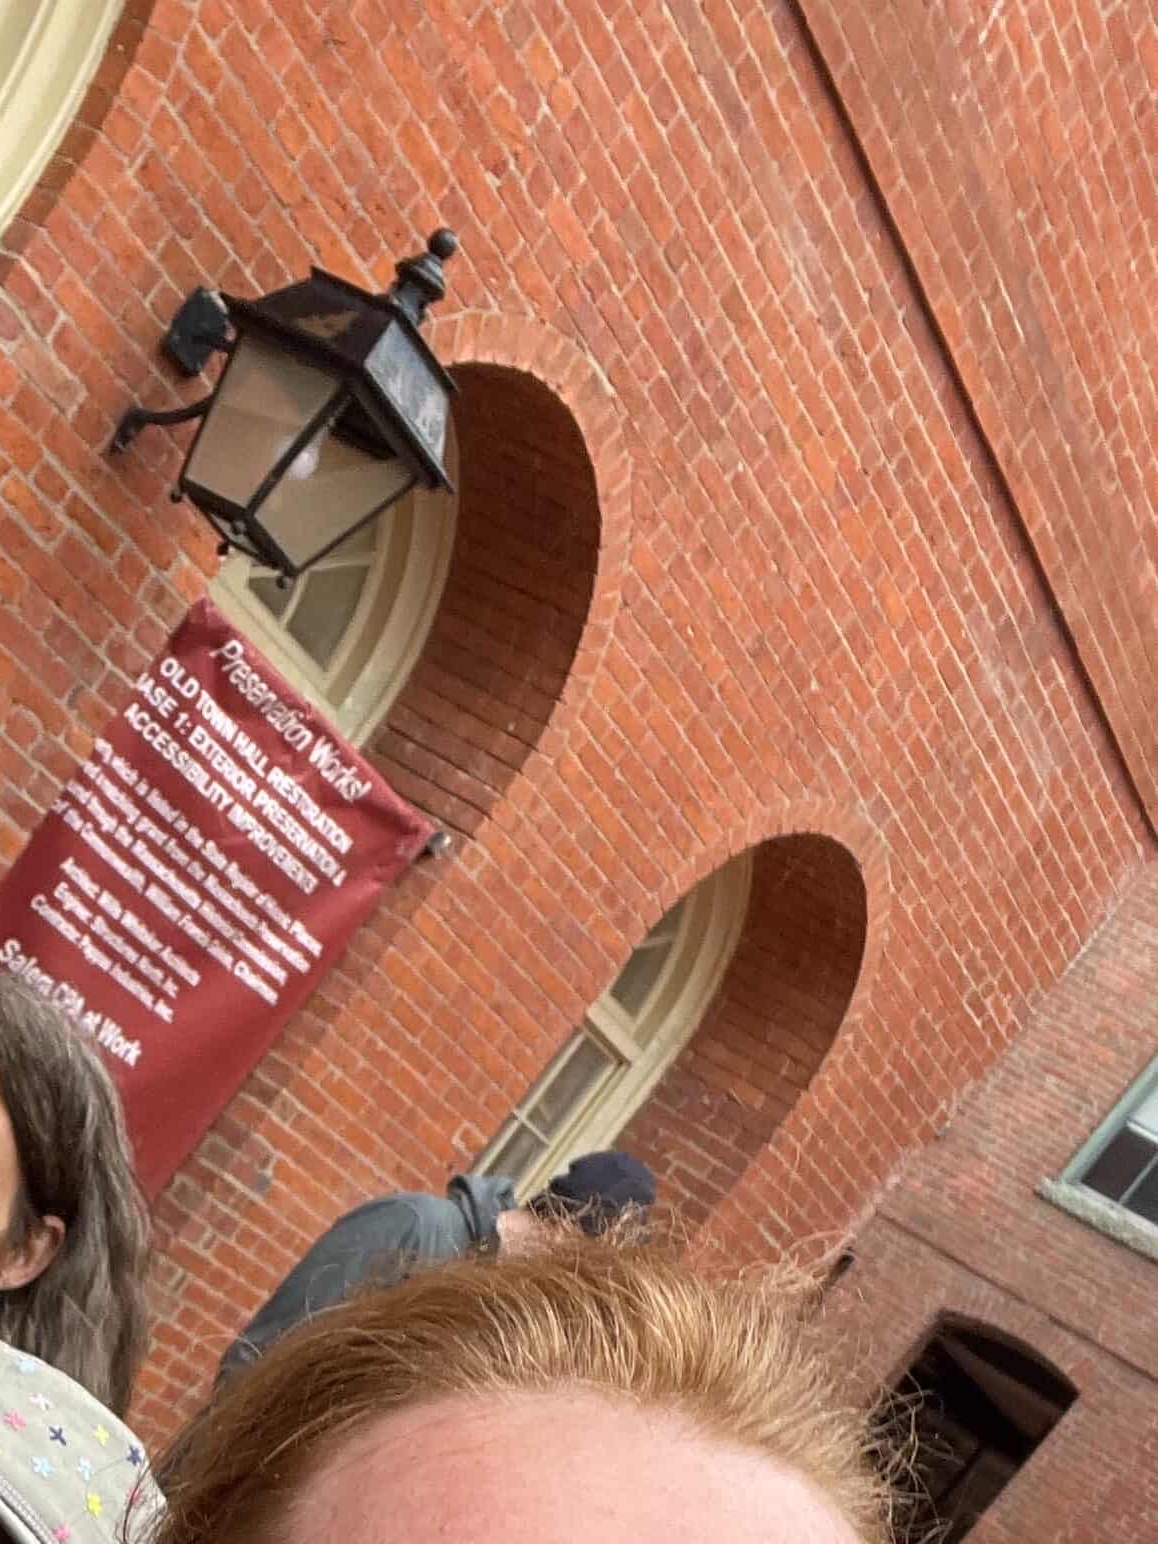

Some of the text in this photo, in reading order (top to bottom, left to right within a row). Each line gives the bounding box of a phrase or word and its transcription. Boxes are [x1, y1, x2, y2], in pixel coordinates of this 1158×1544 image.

[123, 703, 235, 812] ACCESSIBILITY
[226, 800, 318, 894] IMPROVEMENTS
[159, 657, 200, 699] OLD
[195, 689, 239, 743] TOWN
[232, 730, 269, 779] HALL
[265, 766, 353, 855] RESTORATION
[174, 712, 192, 735] 1:
[187, 724, 258, 802] EXTERIOR
[251, 788, 340, 878] PRESERVATION
[209, 639, 373, 800] Preservation Works!
[97, 1017, 141, 1067] Work
